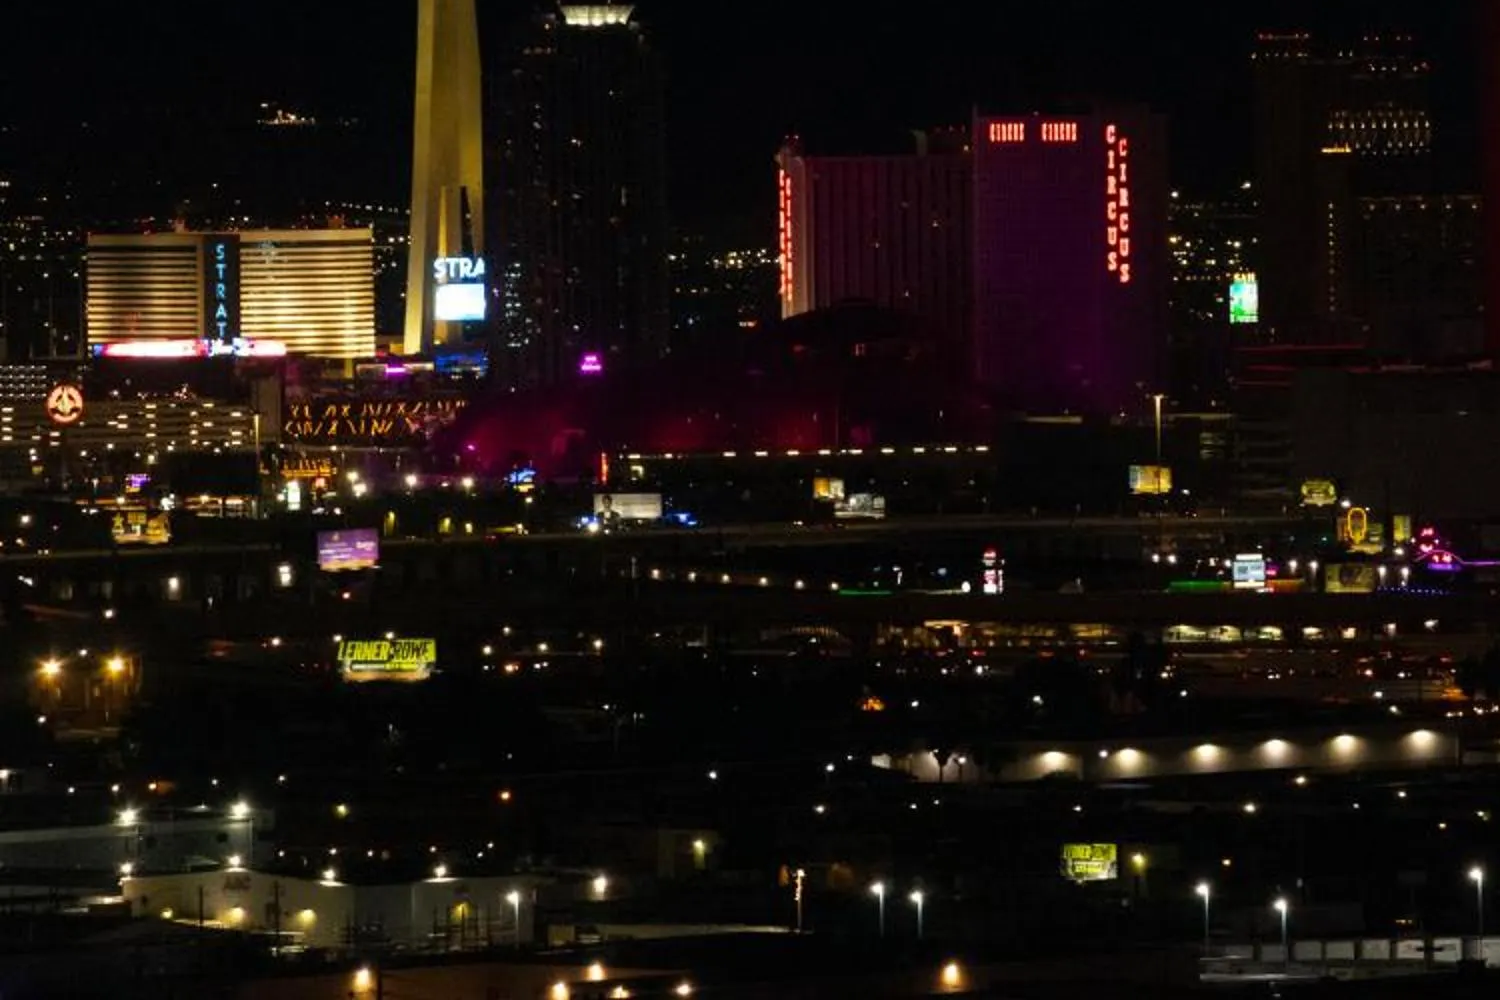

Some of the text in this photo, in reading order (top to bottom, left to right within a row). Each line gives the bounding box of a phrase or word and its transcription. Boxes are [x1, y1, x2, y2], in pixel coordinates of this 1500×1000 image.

[1105, 124, 1118, 271] CIRCUS
[1118, 138, 1130, 283] CIRCUS
[214, 244, 229, 339] STRAT
